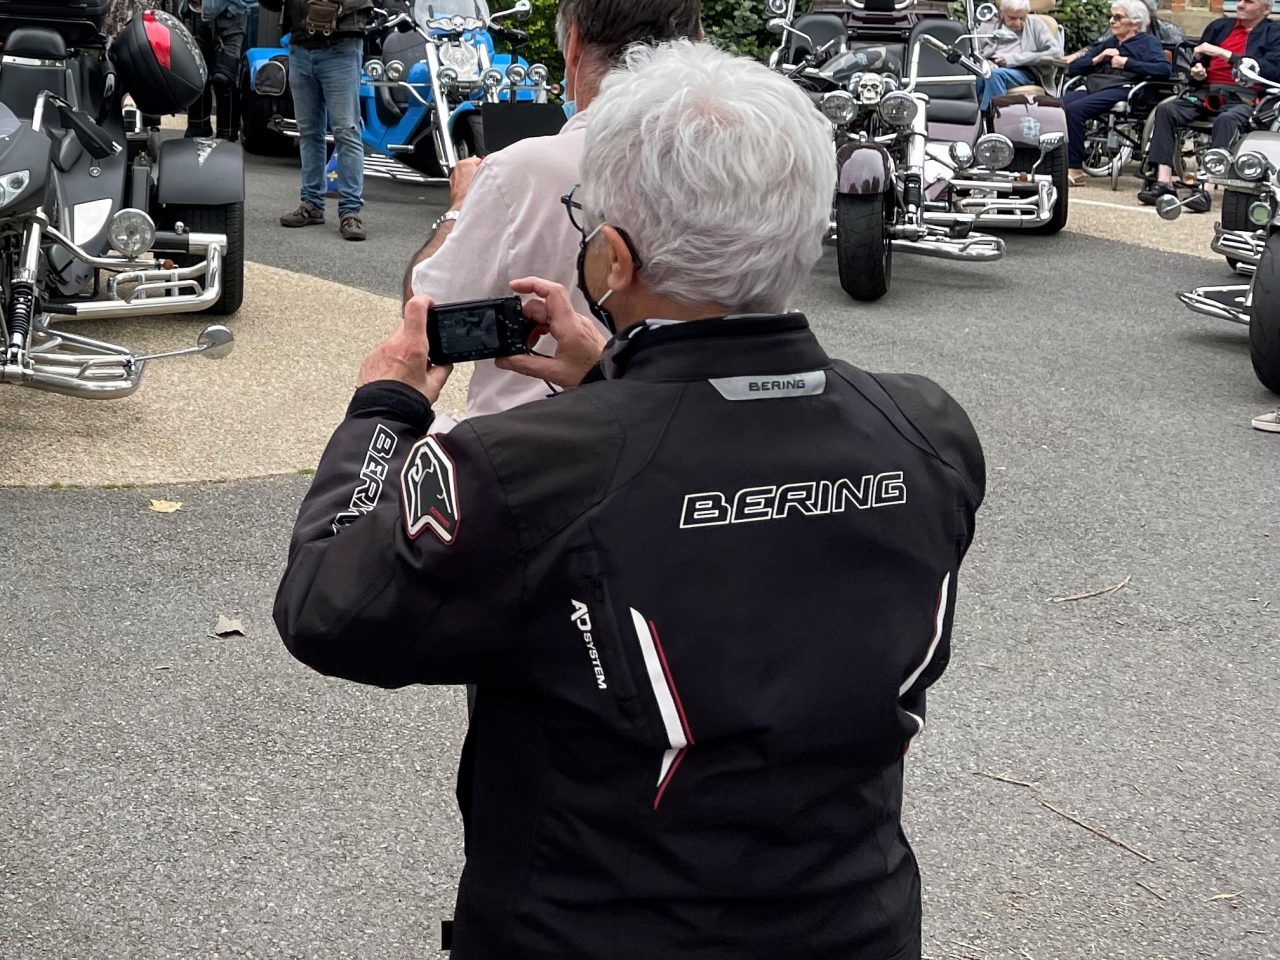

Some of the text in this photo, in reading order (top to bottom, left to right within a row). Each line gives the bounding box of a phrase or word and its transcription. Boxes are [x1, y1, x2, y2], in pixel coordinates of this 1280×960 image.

[748, 380, 806, 392] BERING
[679, 471, 907, 529] BERING
[583, 632, 607, 689] SYSTEM
